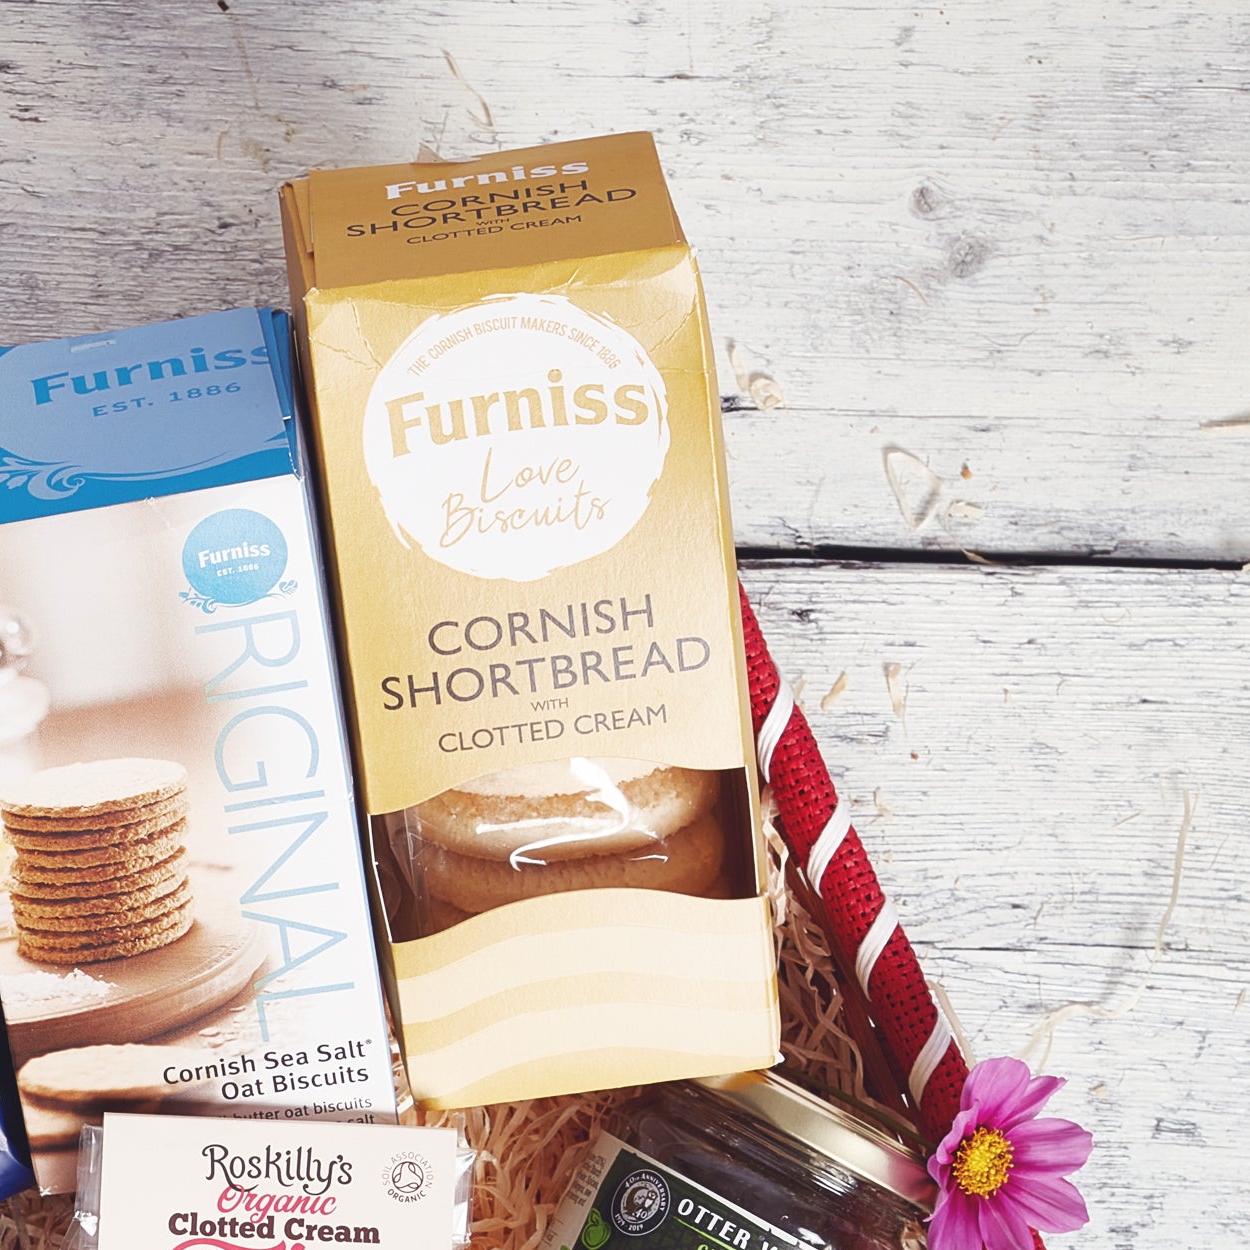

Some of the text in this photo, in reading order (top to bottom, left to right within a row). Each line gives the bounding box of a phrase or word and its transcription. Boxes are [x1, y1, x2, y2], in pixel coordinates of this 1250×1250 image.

[384, 161, 590, 200] Furniss
[390, 179, 588, 217] CORNISH
[346, 187, 637, 238] SHORTBREAD
[406, 214, 582, 245] CLOTTED CREAM
[475, 217, 510, 227] WITH
[406, 316, 622, 377] THE CORNISH BISCUIT MAKERS SINCE 1886
[30, 346, 271, 407] Furniss
[92, 381, 242, 418] EST. 1886
[384, 368, 650, 459] Furniss
[479, 446, 580, 504] Love
[438, 479, 613, 549] Biscuits
[197, 541, 271, 569] Furniss
[427, 593, 655, 656] CORNISH
[381, 635, 712, 712] SHORTBREAD
[529, 697, 570, 713] WITH
[438, 703, 668, 753] CLOTTED CREAM
[162, 1054, 257, 1086] Cornish
[264, 1050, 310, 1071] Sea
[220, 1065, 370, 1101] Oat Biscuits
[284, 1104, 310, 1119] oat
[313, 1096, 373, 1115] biscuits
[201, 1143, 354, 1197] Roskilly's
[216, 1183, 338, 1224] Organic
[387, 1188, 427, 1203] ORGANIC
[167, 1212, 381, 1244] Clotted Cream
[677, 1198, 751, 1250] OTTER
